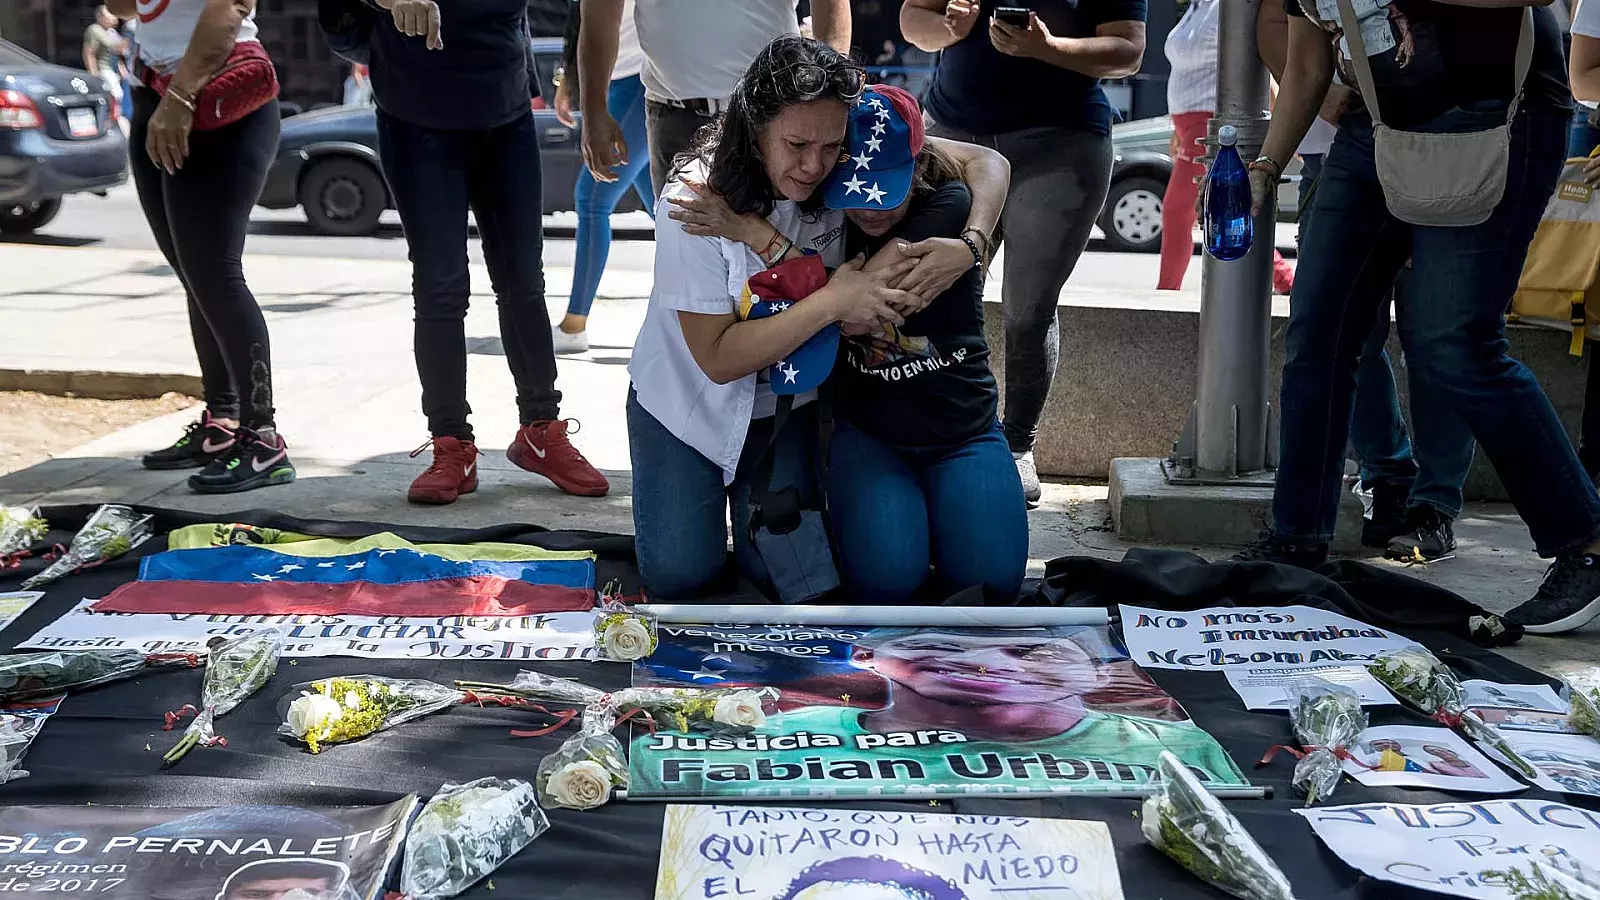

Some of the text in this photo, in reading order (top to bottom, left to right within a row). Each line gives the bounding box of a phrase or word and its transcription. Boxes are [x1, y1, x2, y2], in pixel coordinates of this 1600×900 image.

[287, 624, 466, 639] LUCHAR
[713, 641, 831, 655] menos
[1147, 648, 1304, 667] Nelson
[649, 730, 968, 751] Justicia para
[661, 757, 926, 783] Fabian
[101, 819, 398, 857] PERNALETE
[917, 832, 1021, 856] HASTA
[0, 861, 127, 879] régimen
[32, 879, 126, 892] 2017
[703, 875, 756, 899] EL
